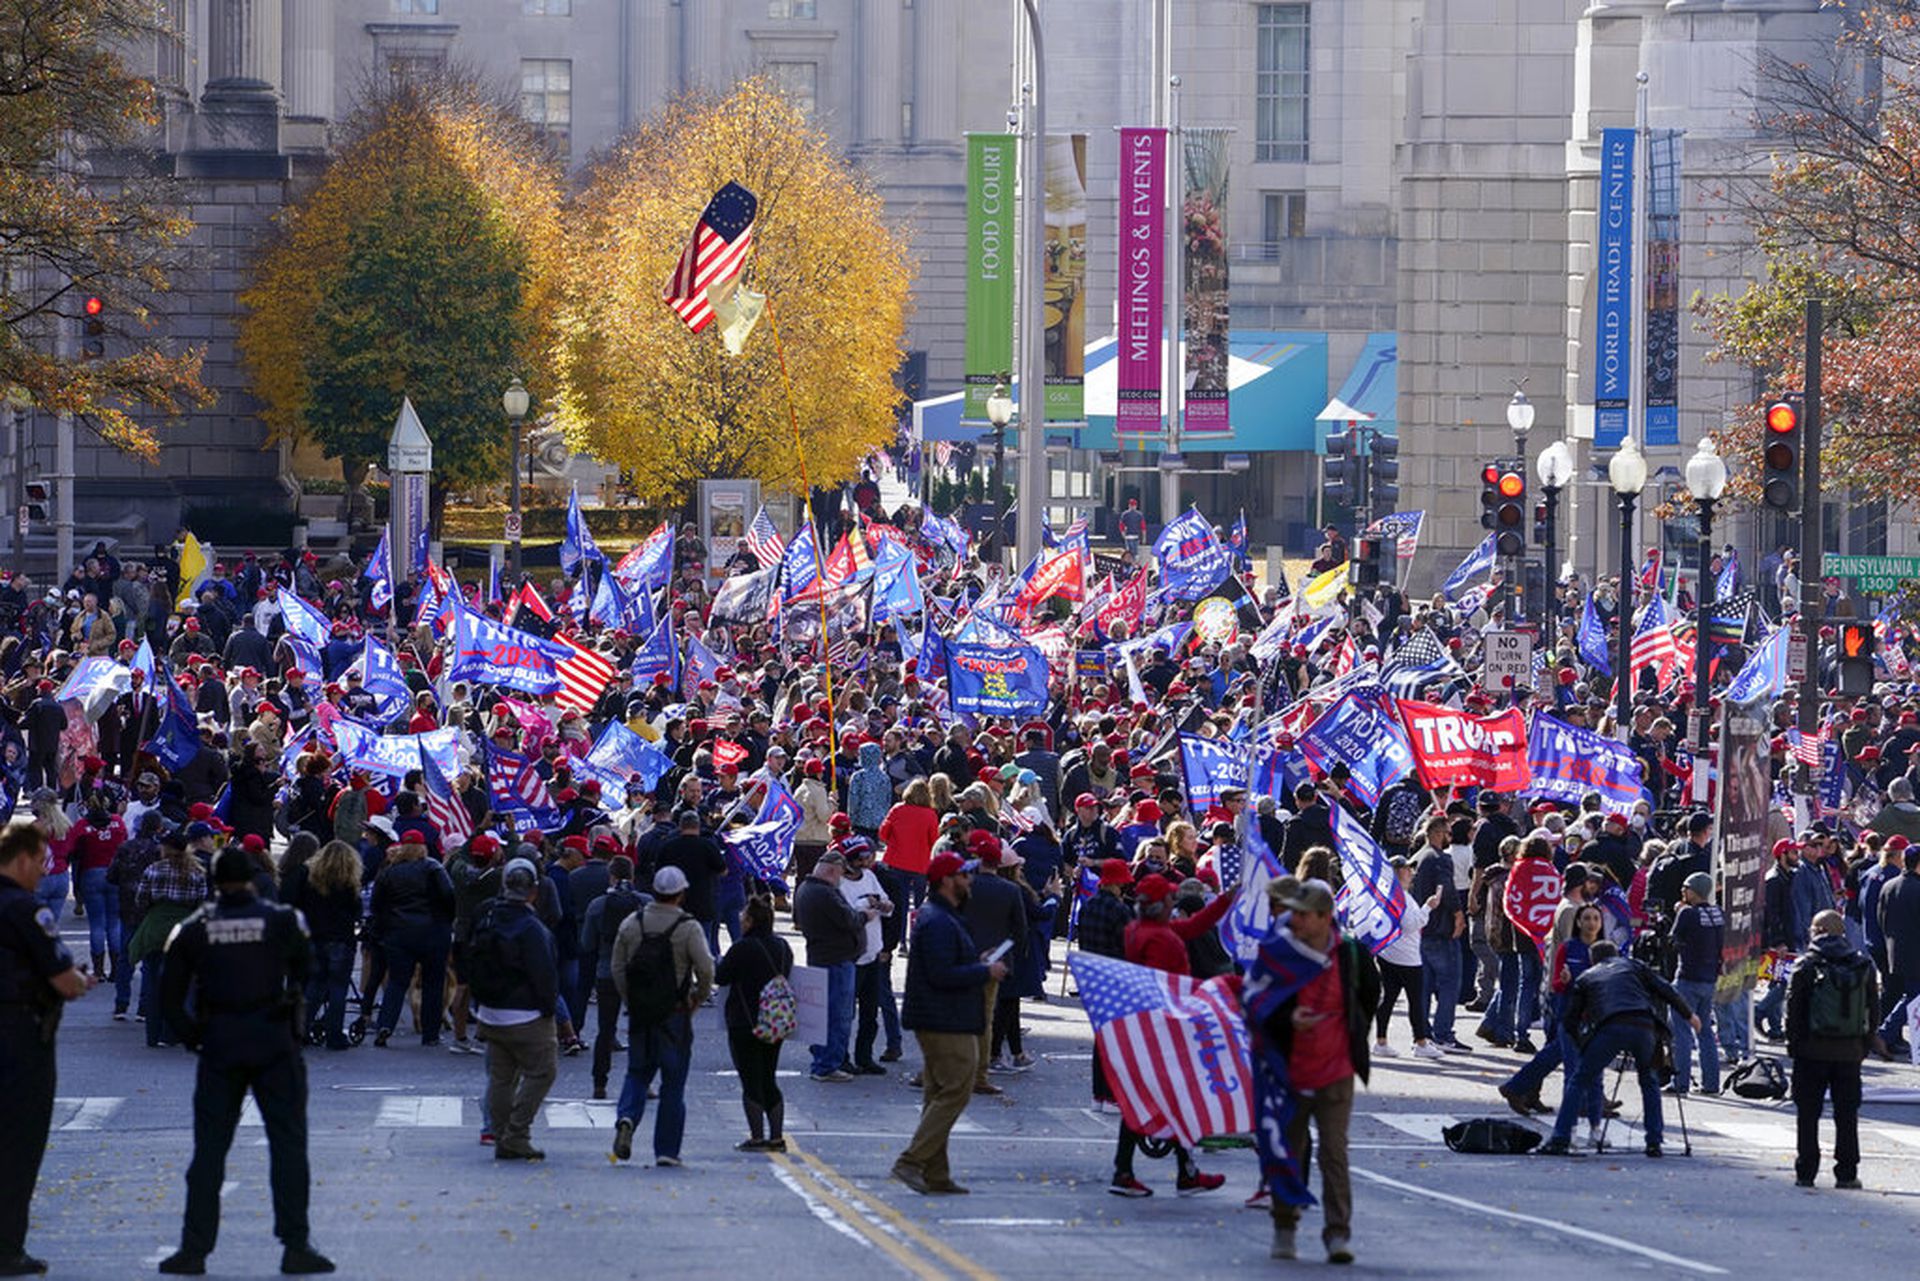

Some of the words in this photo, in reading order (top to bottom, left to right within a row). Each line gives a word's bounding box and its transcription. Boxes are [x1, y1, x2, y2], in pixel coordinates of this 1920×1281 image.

[983, 145, 1001, 214] COURT
[1133, 134, 1152, 217] EVENTS
[1608, 142, 1625, 228] CENTER
[982, 221, 999, 281] FOOD
[1131, 224, 1152, 240] &
[1606, 238, 1622, 303] TRADE
[1131, 247, 1151, 361] MEETINGS
[1604, 311, 1621, 393] WORLD
[1825, 558, 1914, 577] PENNSYLVANIA
[1861, 577, 1894, 590] 1300
[1495, 650, 1522, 661] TURN
[1498, 637, 1518, 649] NO
[955, 656, 1028, 674] TRUMP
[1488, 663, 1502, 673] ON
[1507, 663, 1527, 674] RED
[1337, 699, 1407, 761] TRUMP
[1413, 715, 1515, 755] TRUMP
[208, 930, 262, 944] POLICE
